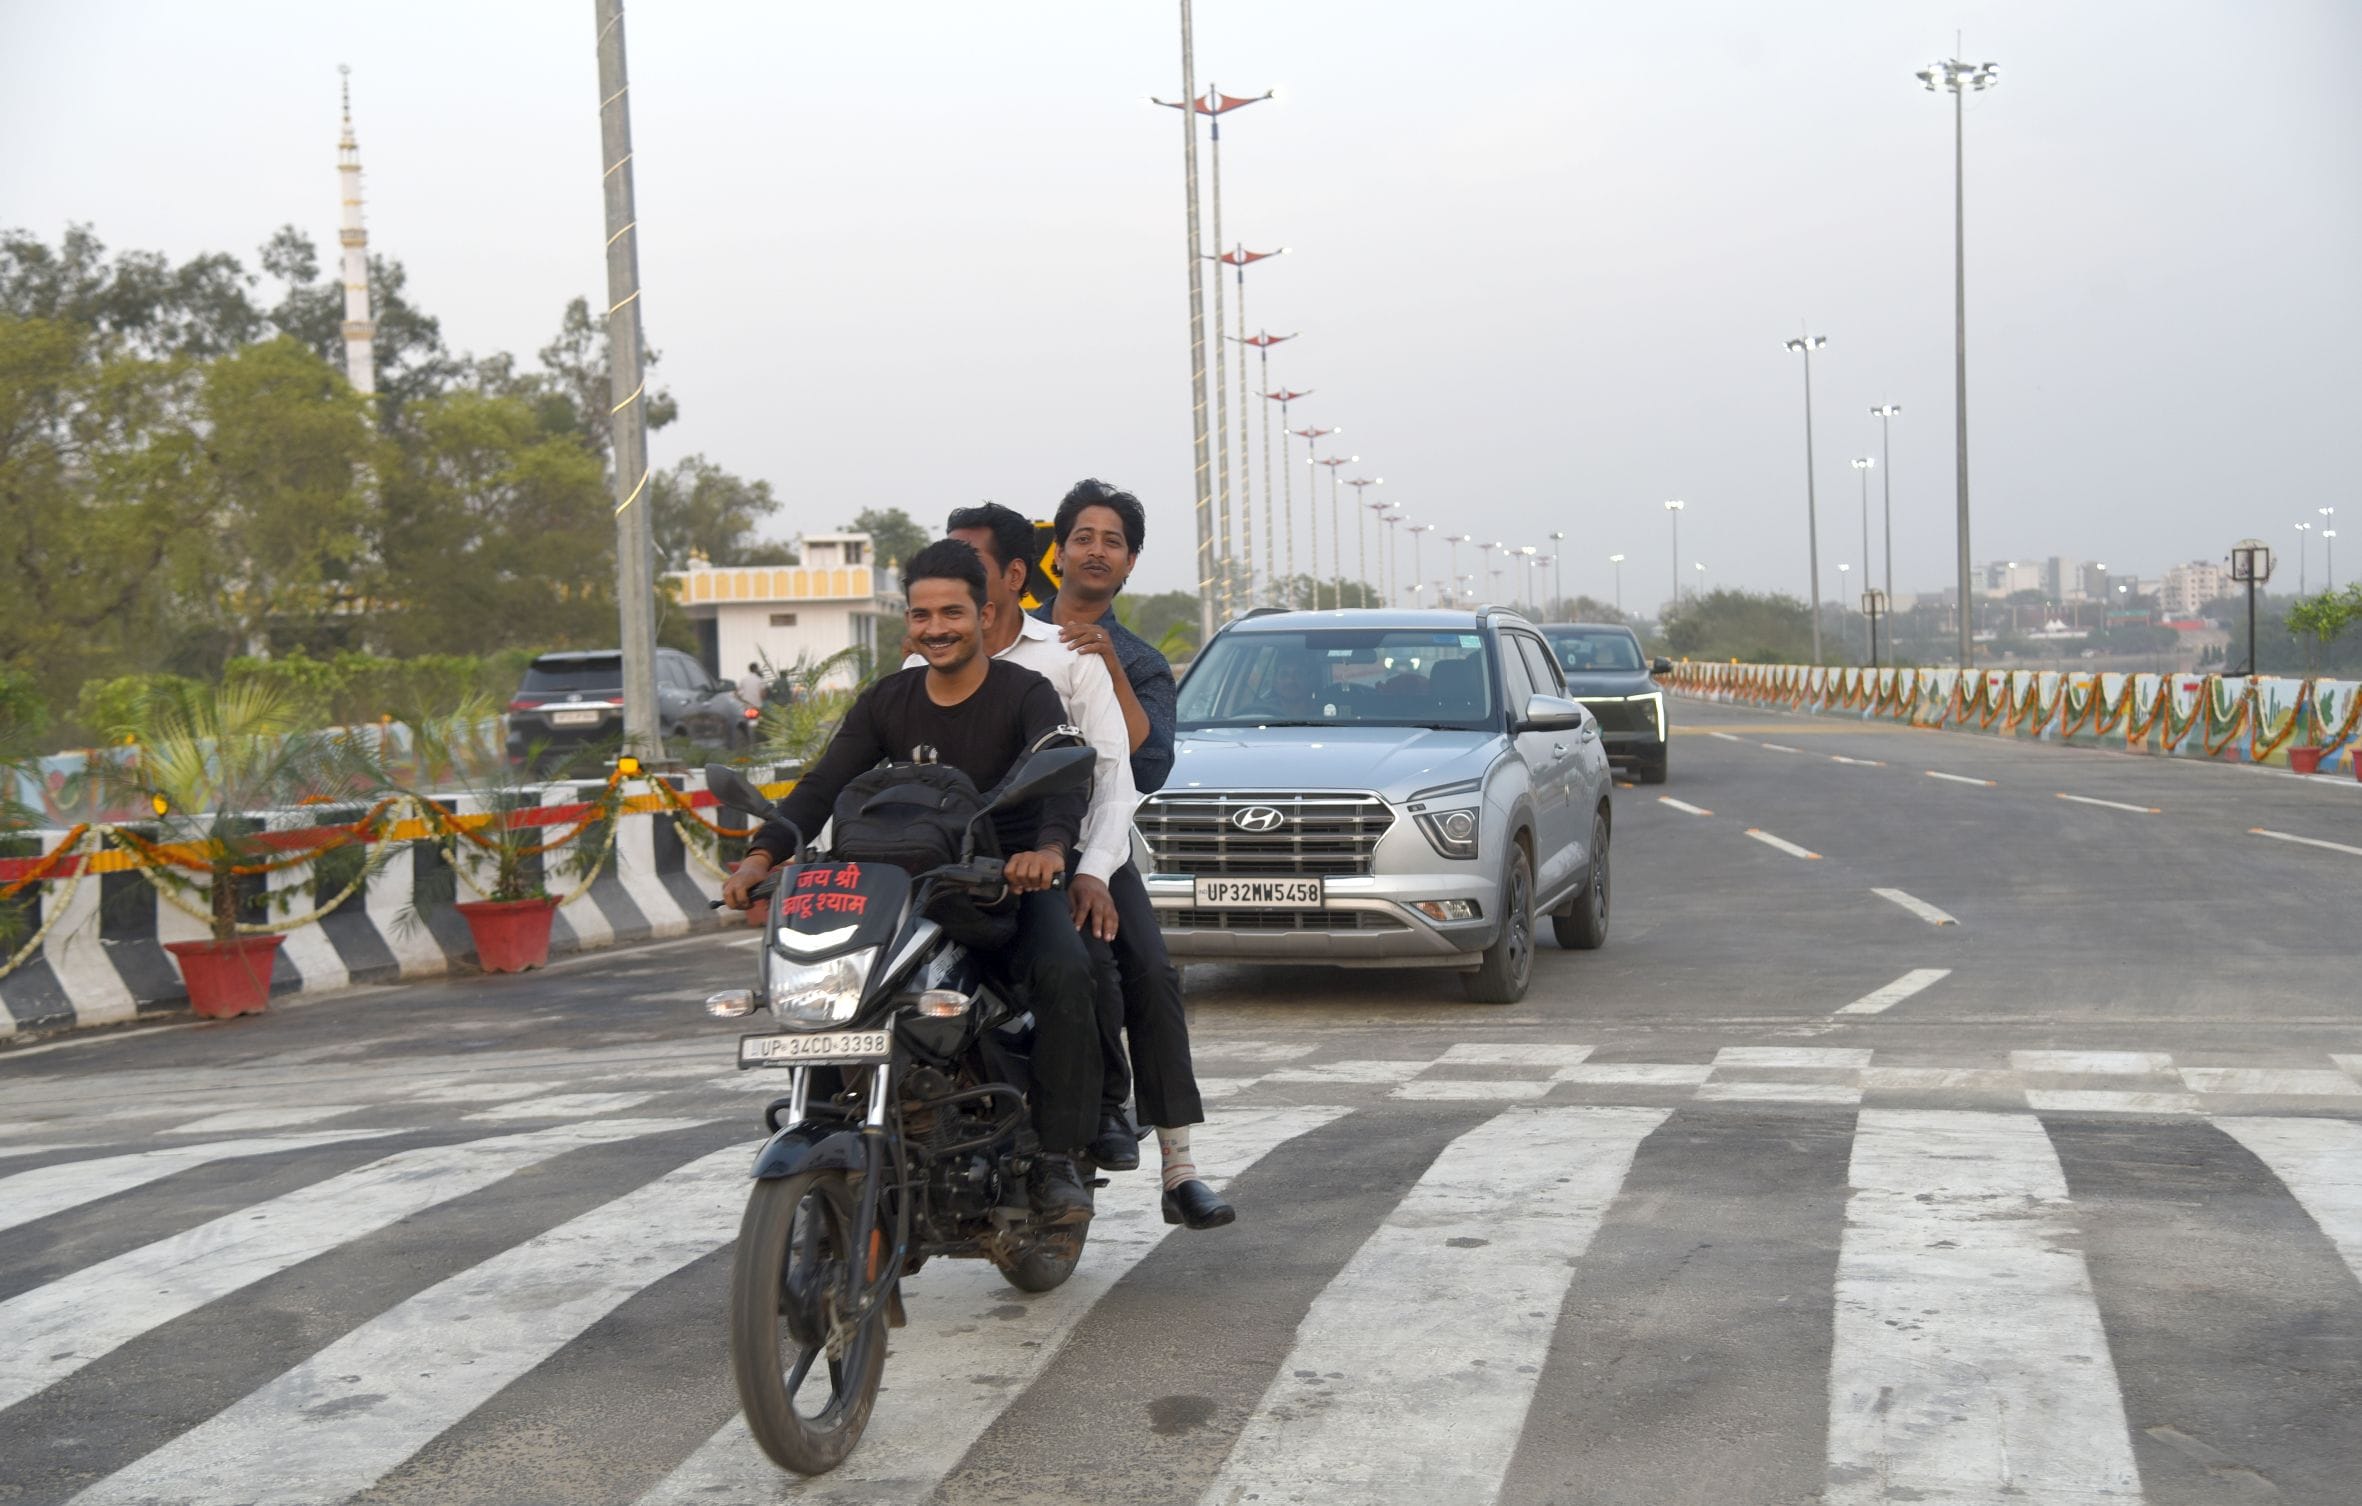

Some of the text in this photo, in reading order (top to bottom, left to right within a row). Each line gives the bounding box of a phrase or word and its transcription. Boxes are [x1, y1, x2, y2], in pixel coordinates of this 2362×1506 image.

[797, 863, 861, 889] जय श्री
[1207, 883, 1318, 901] UP32MW5458
[816, 893, 868, 915] श्याम
